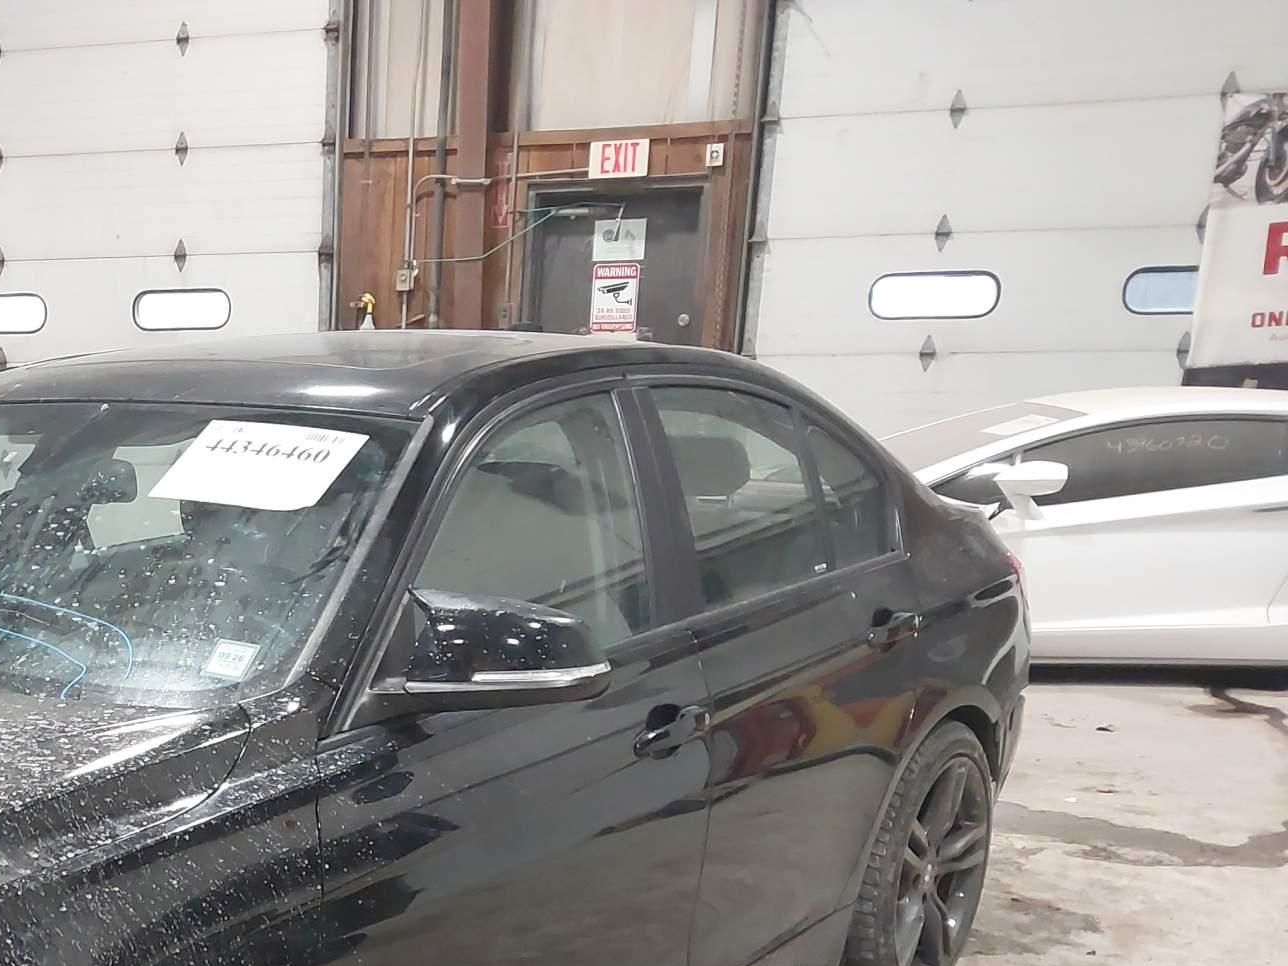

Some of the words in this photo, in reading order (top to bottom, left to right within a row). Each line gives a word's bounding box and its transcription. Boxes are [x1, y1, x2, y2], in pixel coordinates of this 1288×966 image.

[600, 142, 640, 174] EXIT
[596, 266, 637, 277] WARNING
[205, 438, 331, 464] 44346460
